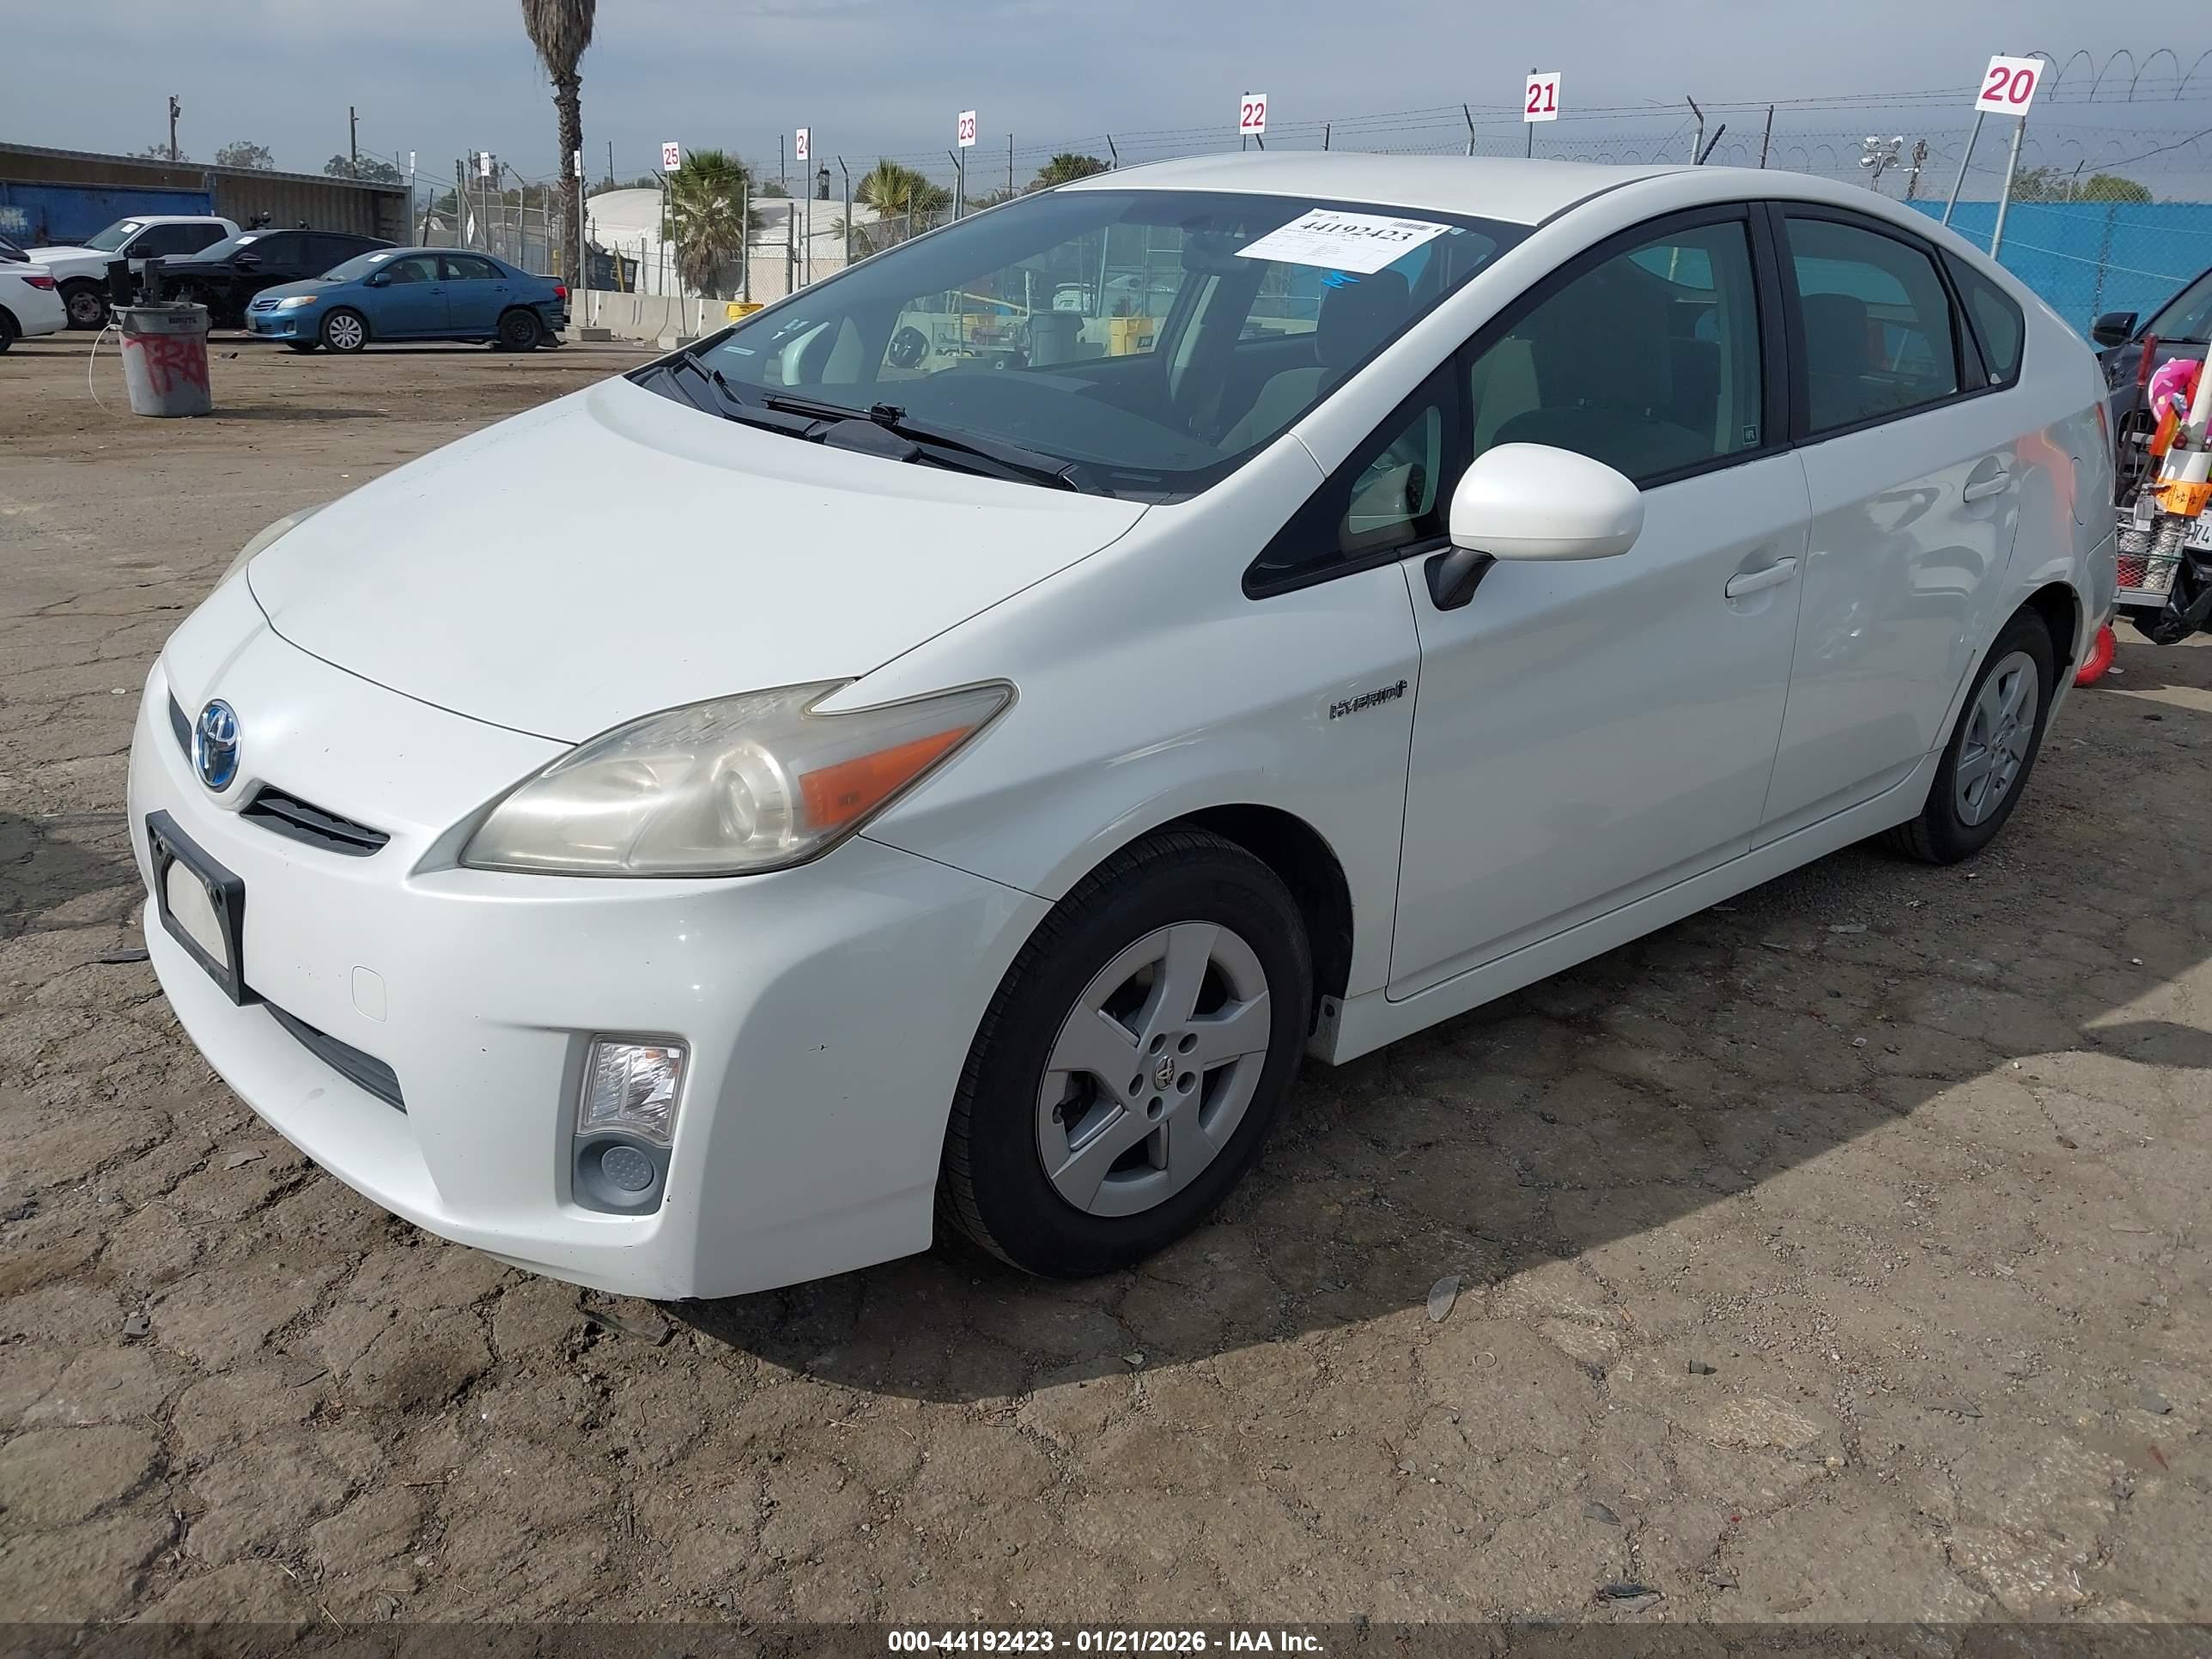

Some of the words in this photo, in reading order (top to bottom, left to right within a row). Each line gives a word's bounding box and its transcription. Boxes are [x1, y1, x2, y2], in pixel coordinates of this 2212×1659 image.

[1982, 66, 2034, 104] 20
[1527, 82, 1556, 113] 21
[1242, 102, 1265, 127] 22
[960, 118, 975, 140] 23
[481, 156, 489, 173] 27
[664, 148, 678, 166] 25
[1299, 221, 1414, 241] 44192423
